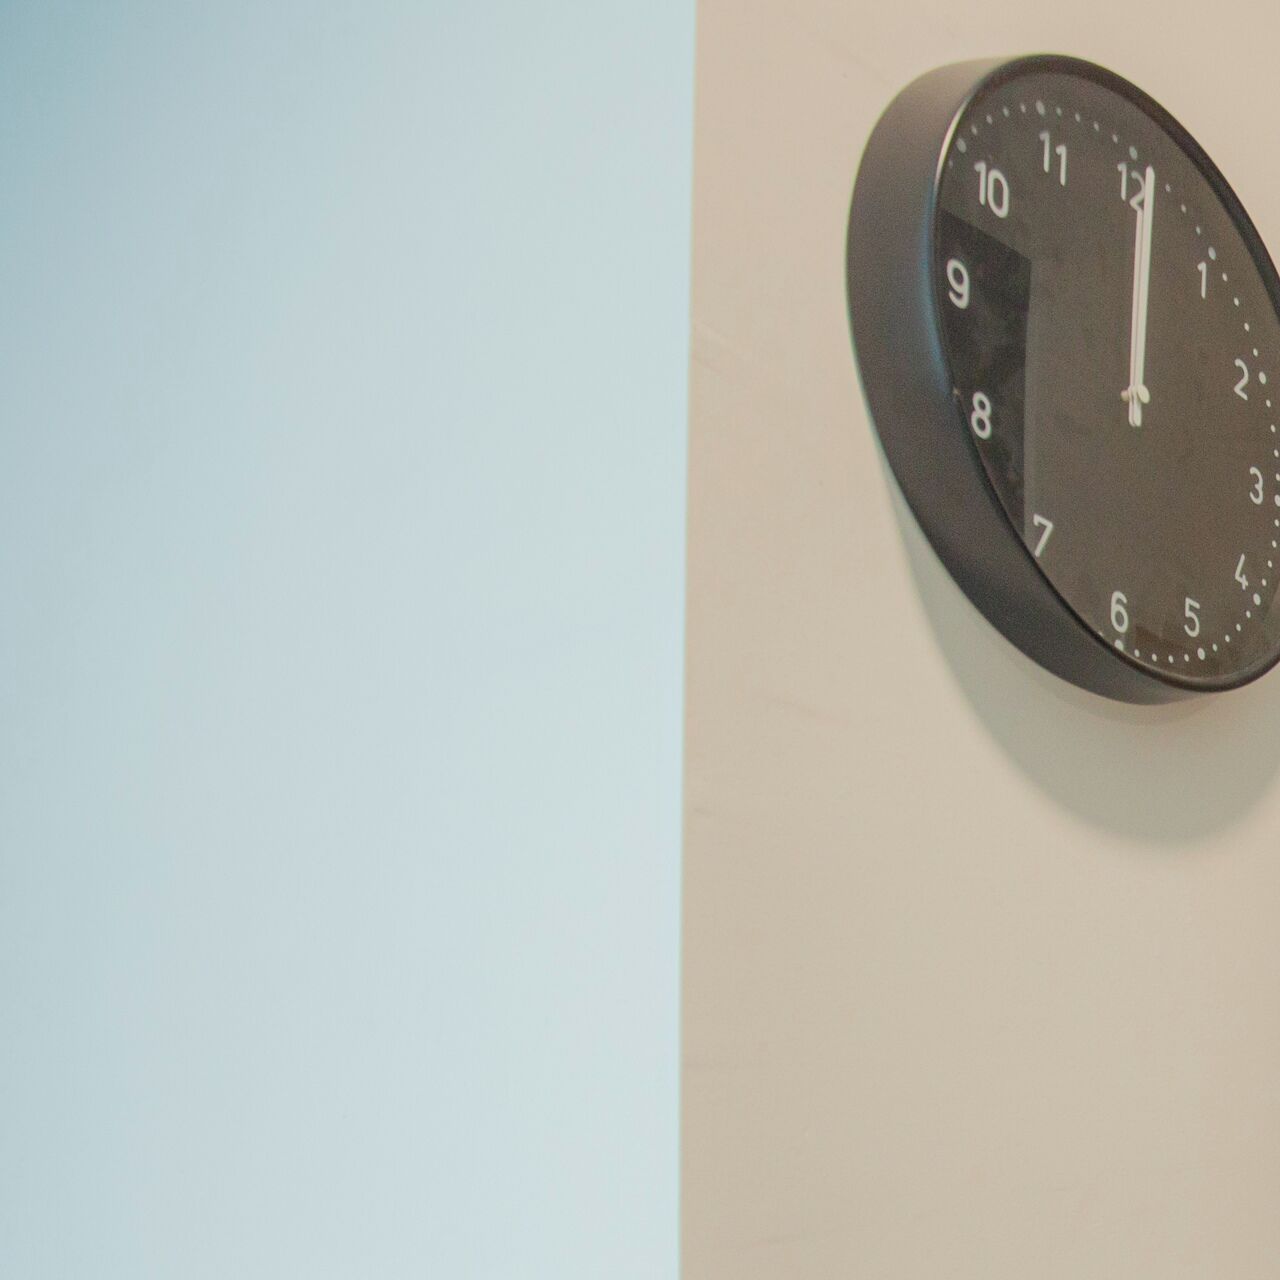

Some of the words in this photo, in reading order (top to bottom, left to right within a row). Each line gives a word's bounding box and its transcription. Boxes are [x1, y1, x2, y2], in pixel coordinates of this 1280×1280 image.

[1039, 130, 1067, 187] 11
[974, 160, 1010, 219] 10
[1117, 162, 1151, 212] 12
[946, 258, 970, 310] 9
[1197, 261, 1207, 299] 1
[1234, 358, 1249, 401] 2
[971, 391, 992, 440] 8
[1250, 467, 1264, 505] 3
[1033, 513, 1054, 557] 7
[1235, 553, 1248, 590] 4
[1110, 591, 1129, 633] 6
[1184, 597, 1200, 637] 5
